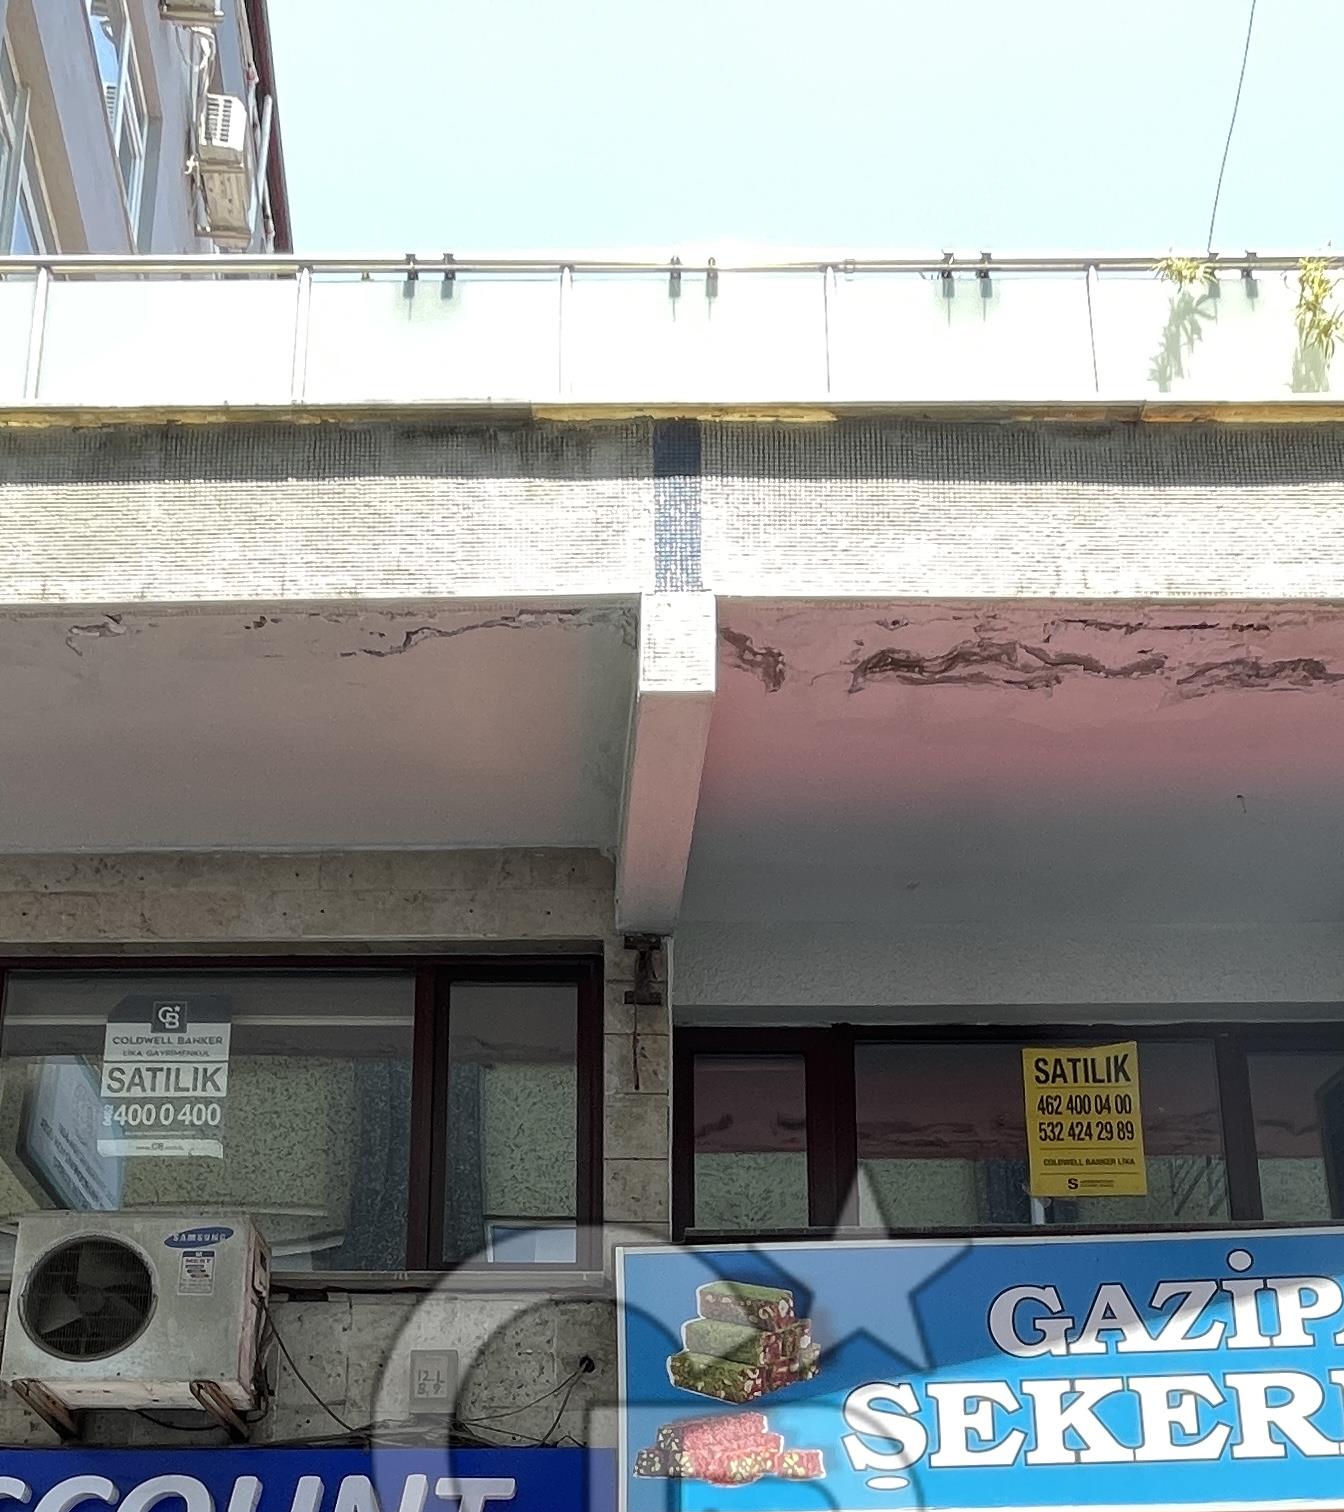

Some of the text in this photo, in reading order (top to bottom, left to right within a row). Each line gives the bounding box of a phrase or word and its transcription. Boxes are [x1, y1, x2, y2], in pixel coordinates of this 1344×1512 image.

[112, 1035, 224, 1046] COLDWELL BANKER
[106, 1065, 223, 1094] SATILIK
[1034, 1053, 1132, 1085] SATILIK
[113, 1103, 157, 1126] 400
[177, 1103, 222, 1126] 400
[1036, 1093, 1133, 1116] 462 400 04 00
[1038, 1120, 1135, 1142] 532 424 29 89
[173, 1232, 227, 1242] SAMSUNG
